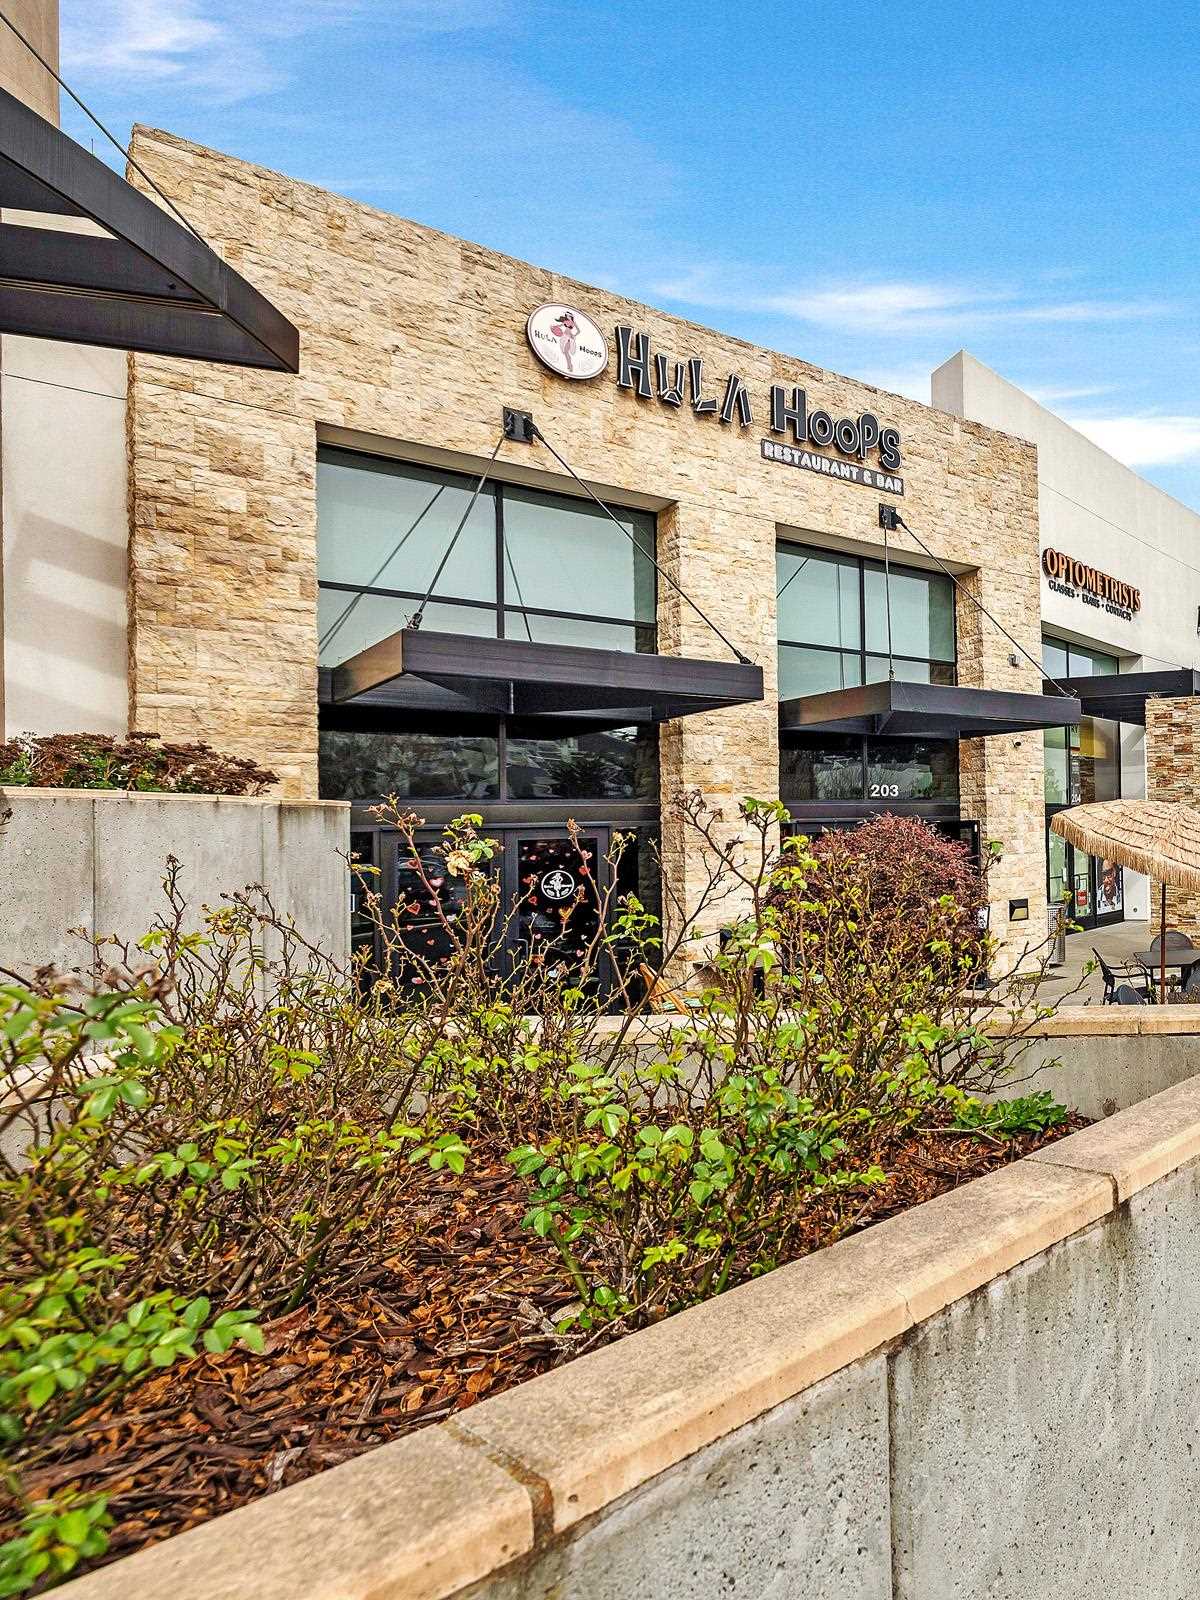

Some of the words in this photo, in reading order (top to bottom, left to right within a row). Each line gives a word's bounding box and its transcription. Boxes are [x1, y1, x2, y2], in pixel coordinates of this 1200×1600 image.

[614, 325, 752, 427] HULA
[770, 385, 901, 471] HOOPS
[764, 441, 860, 481] RESTAURANT
[863, 469, 873, 486] &
[876, 475, 903, 493] BAR
[1042, 548, 1140, 612] OPTOMETRISTS
[1048, 580, 1075, 598] GLASSES
[870, 783, 899, 797] 203
